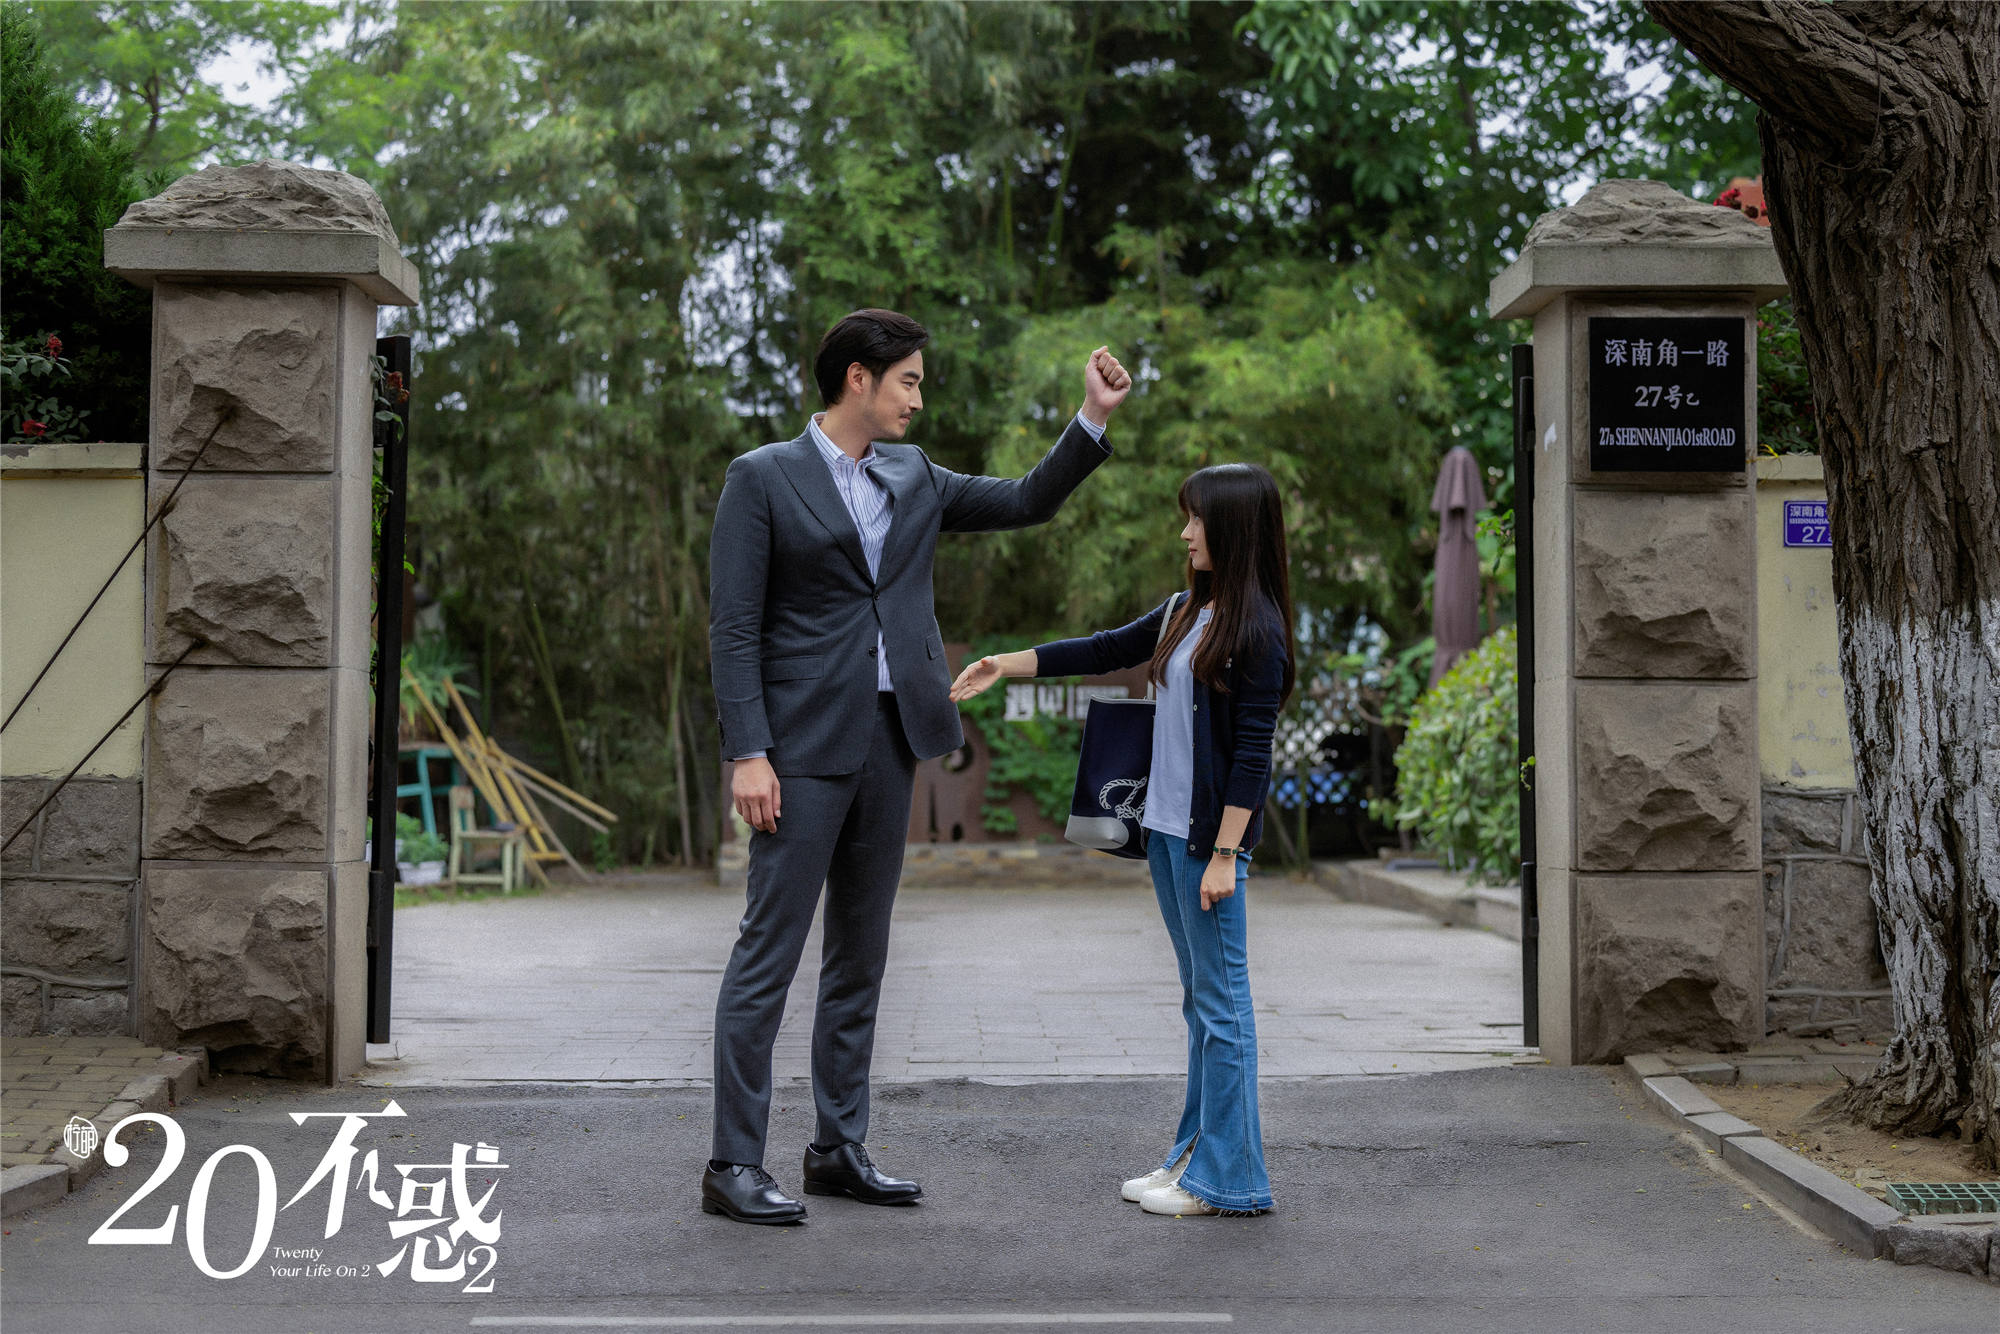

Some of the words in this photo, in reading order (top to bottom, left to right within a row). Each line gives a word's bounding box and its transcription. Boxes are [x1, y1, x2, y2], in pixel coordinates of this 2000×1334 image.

[1604, 338, 1729, 367] 深南角一路
[1634, 384, 1700, 410] 27号乙
[1790, 505, 1828, 517] 深南角
